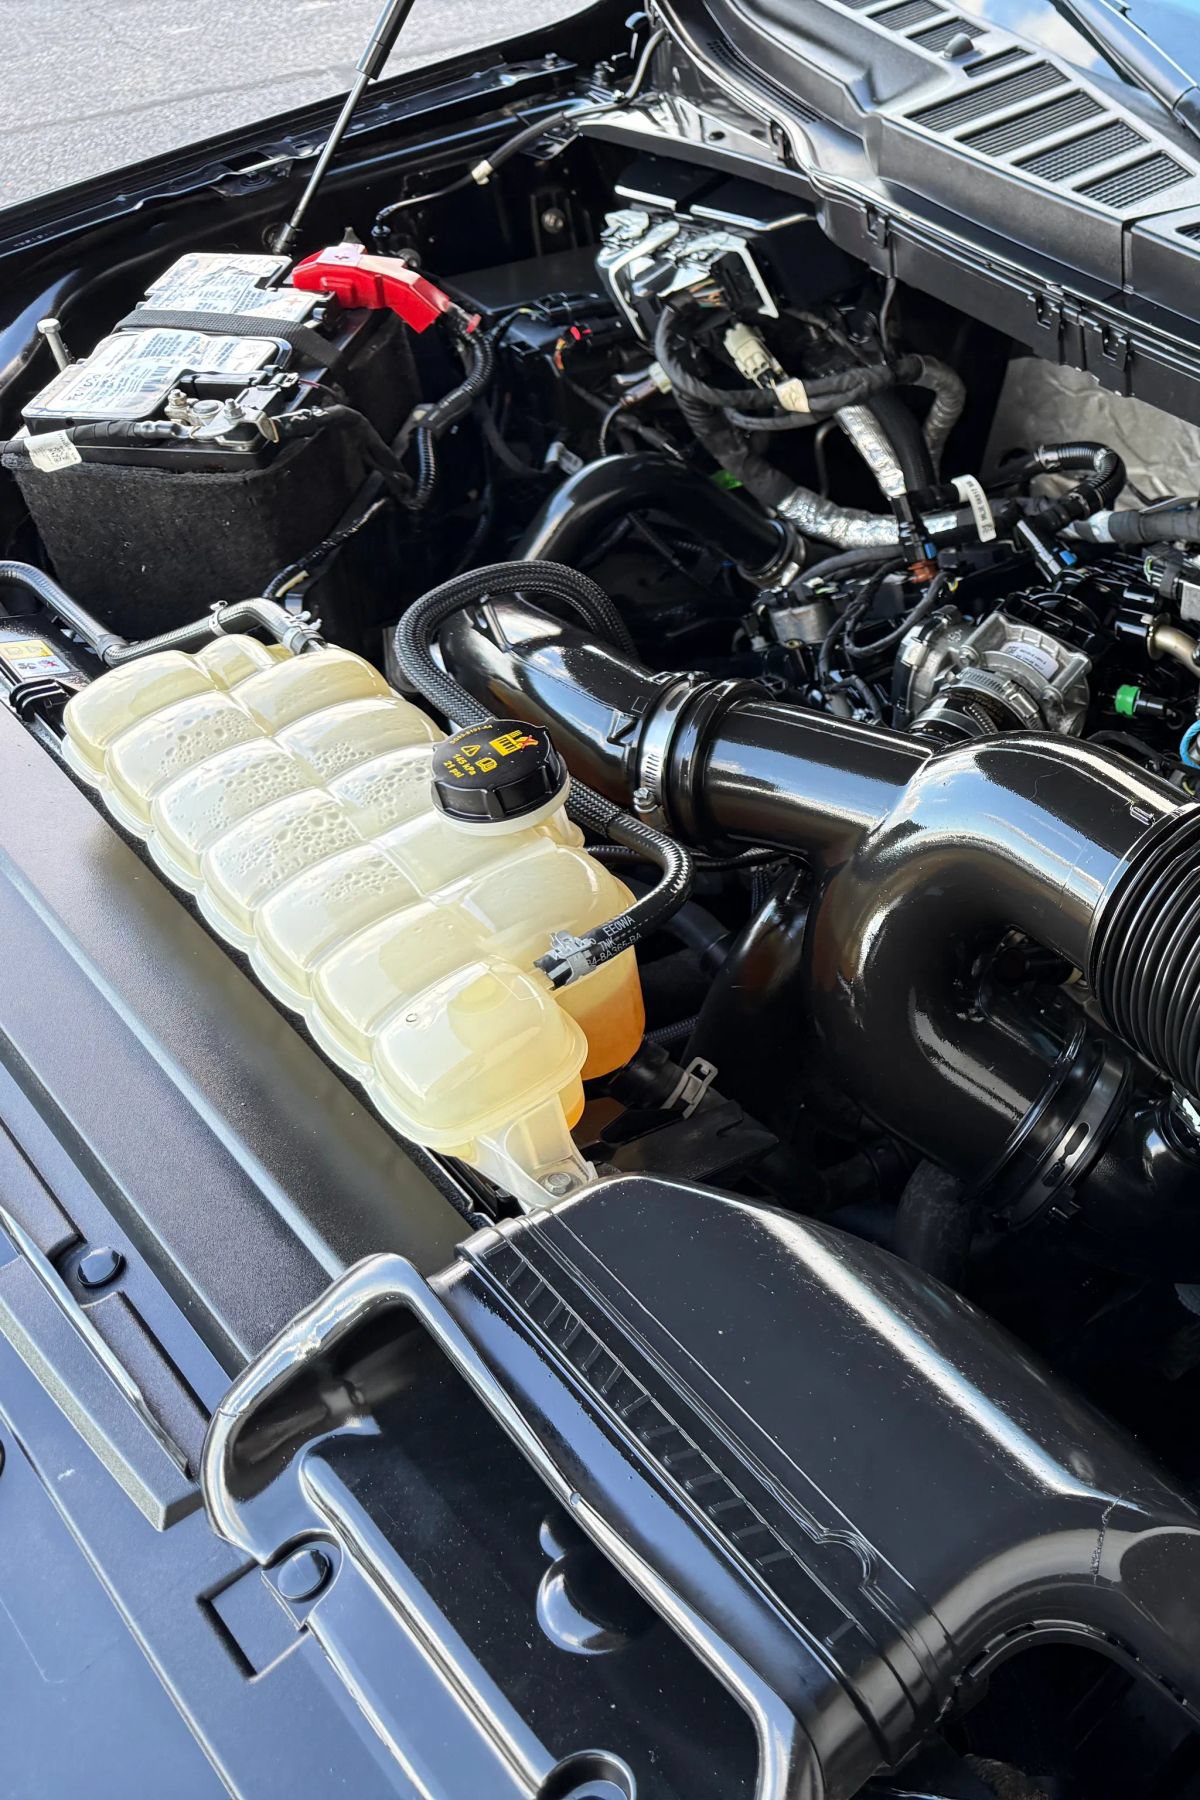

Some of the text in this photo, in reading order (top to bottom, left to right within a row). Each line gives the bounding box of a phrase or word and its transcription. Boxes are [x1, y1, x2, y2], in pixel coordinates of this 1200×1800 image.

[443, 760, 464, 778] 21 psi
[453, 754, 476, 776] 145 kPa
